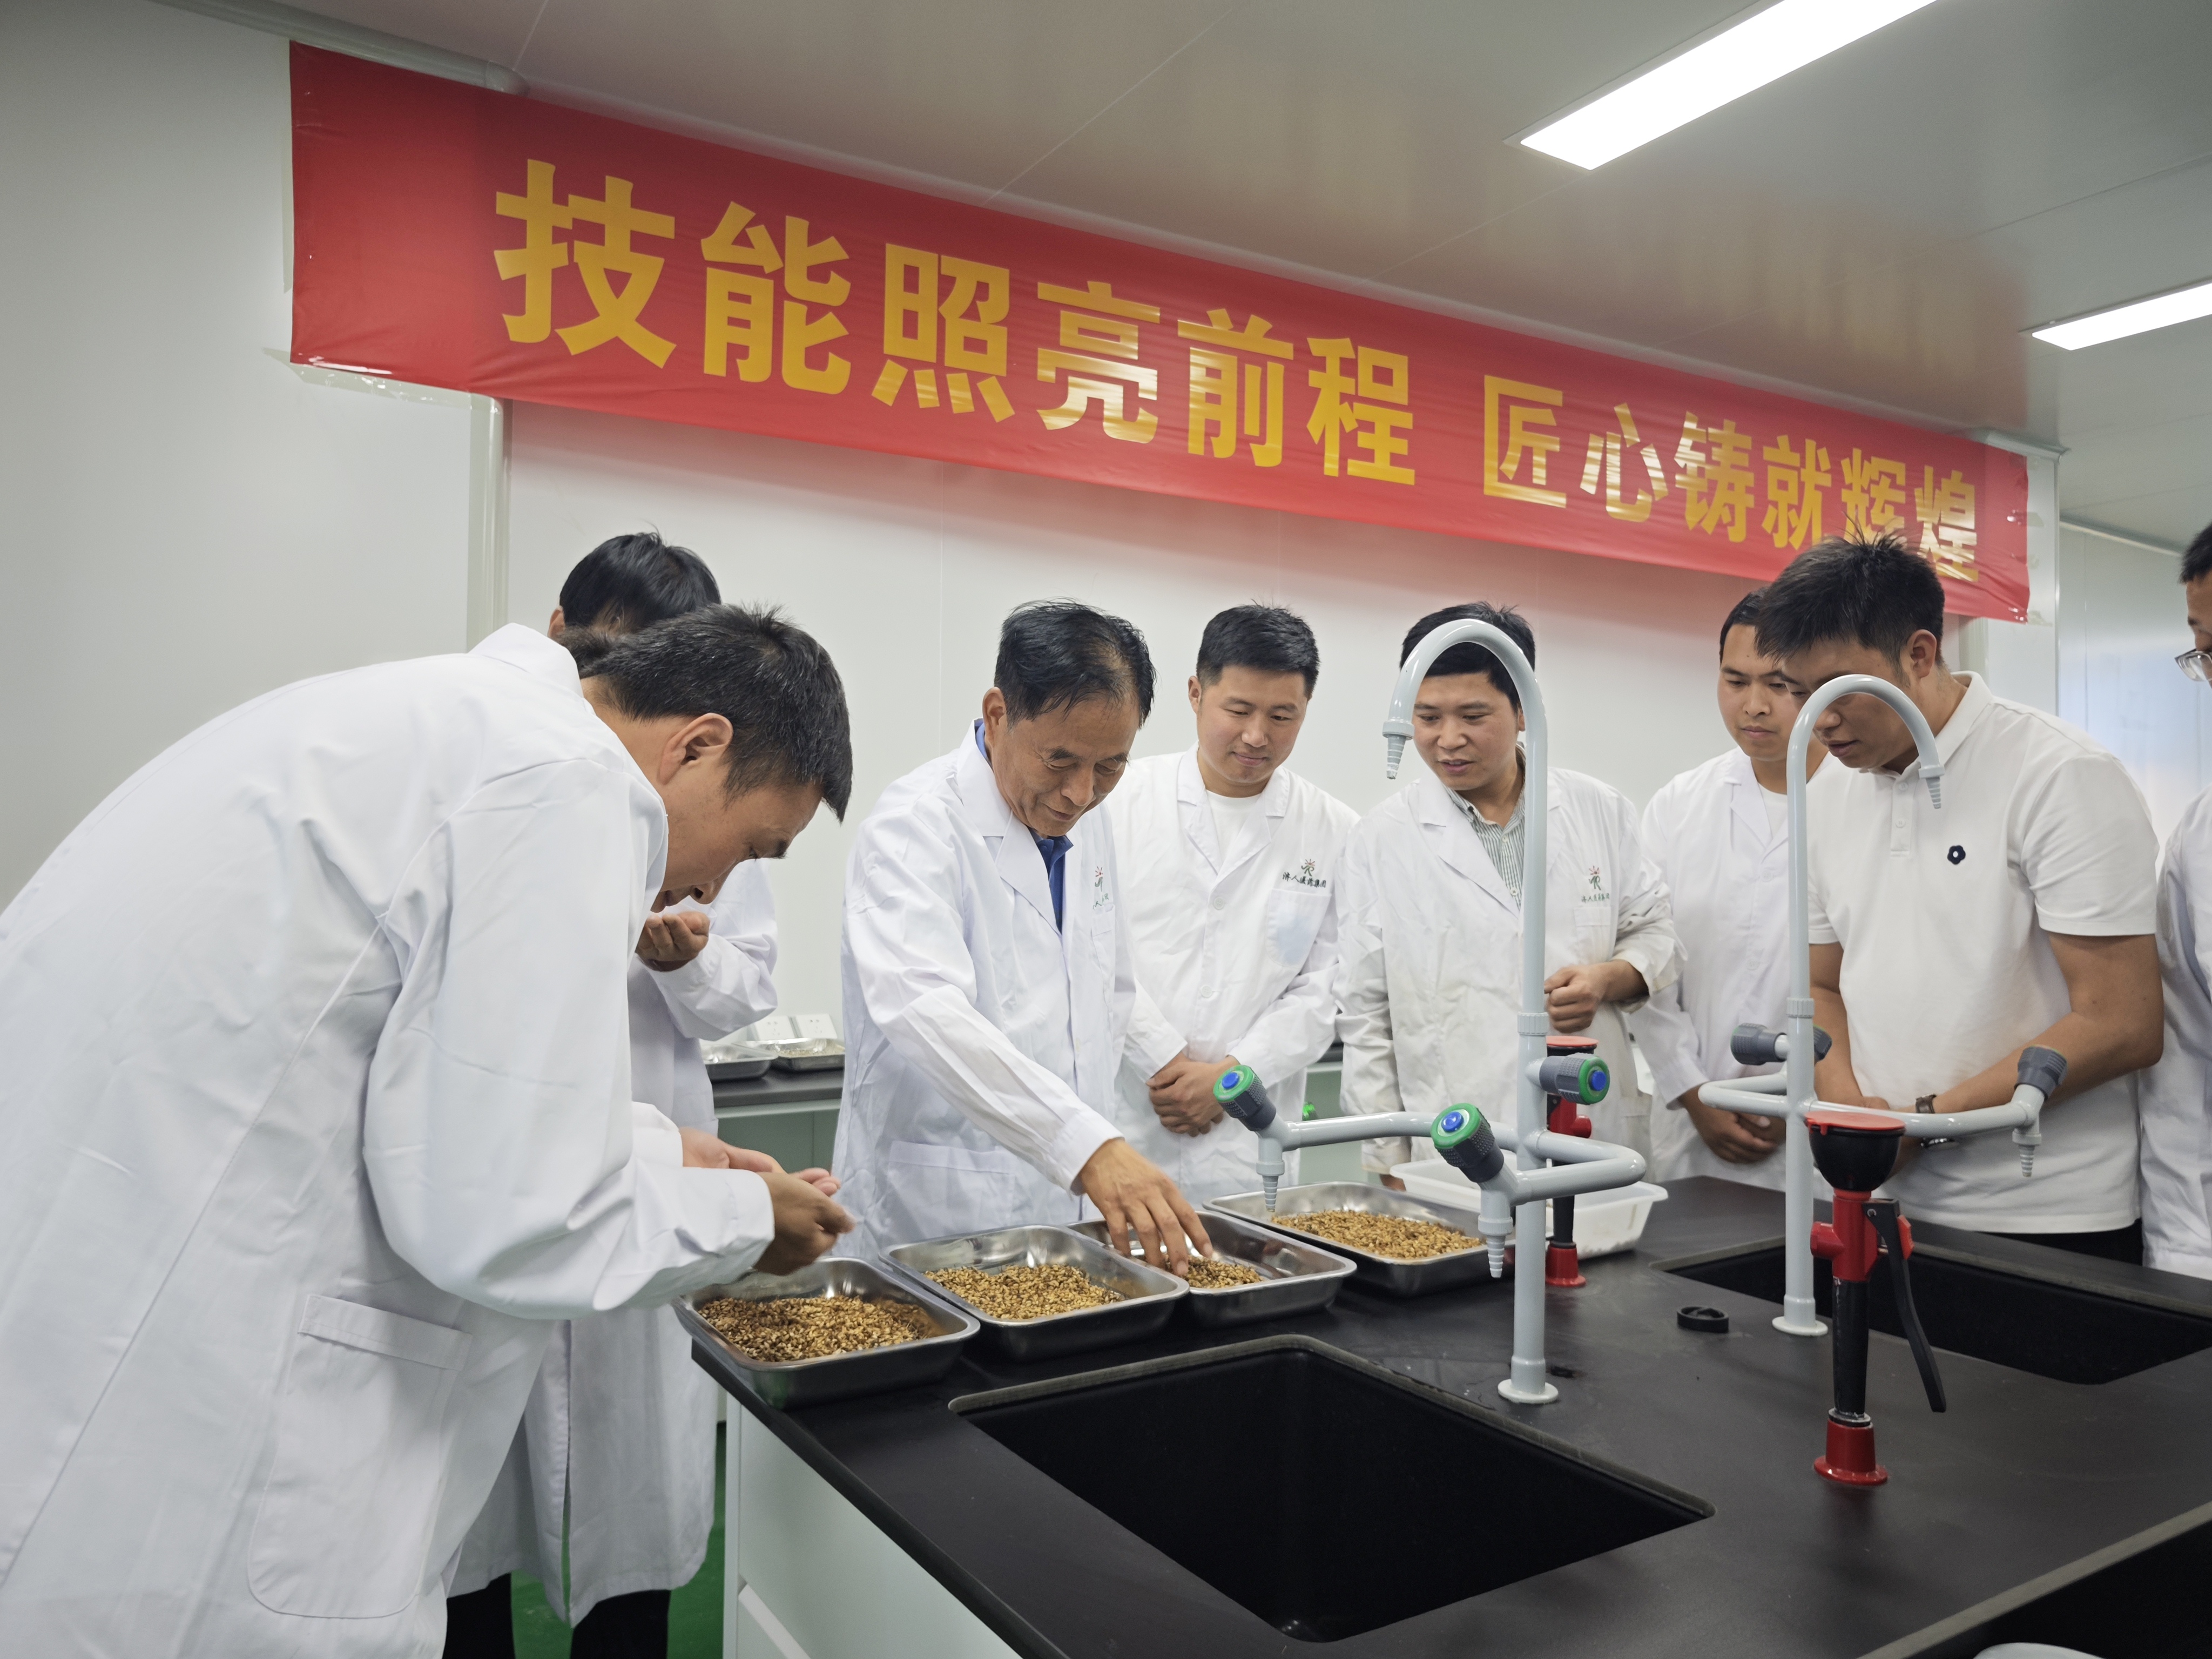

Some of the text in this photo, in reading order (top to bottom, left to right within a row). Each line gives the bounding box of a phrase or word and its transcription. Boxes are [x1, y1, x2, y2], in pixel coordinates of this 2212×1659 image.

[494, 158, 1979, 582] 技能照亮前程 匠心铸就辉煌
